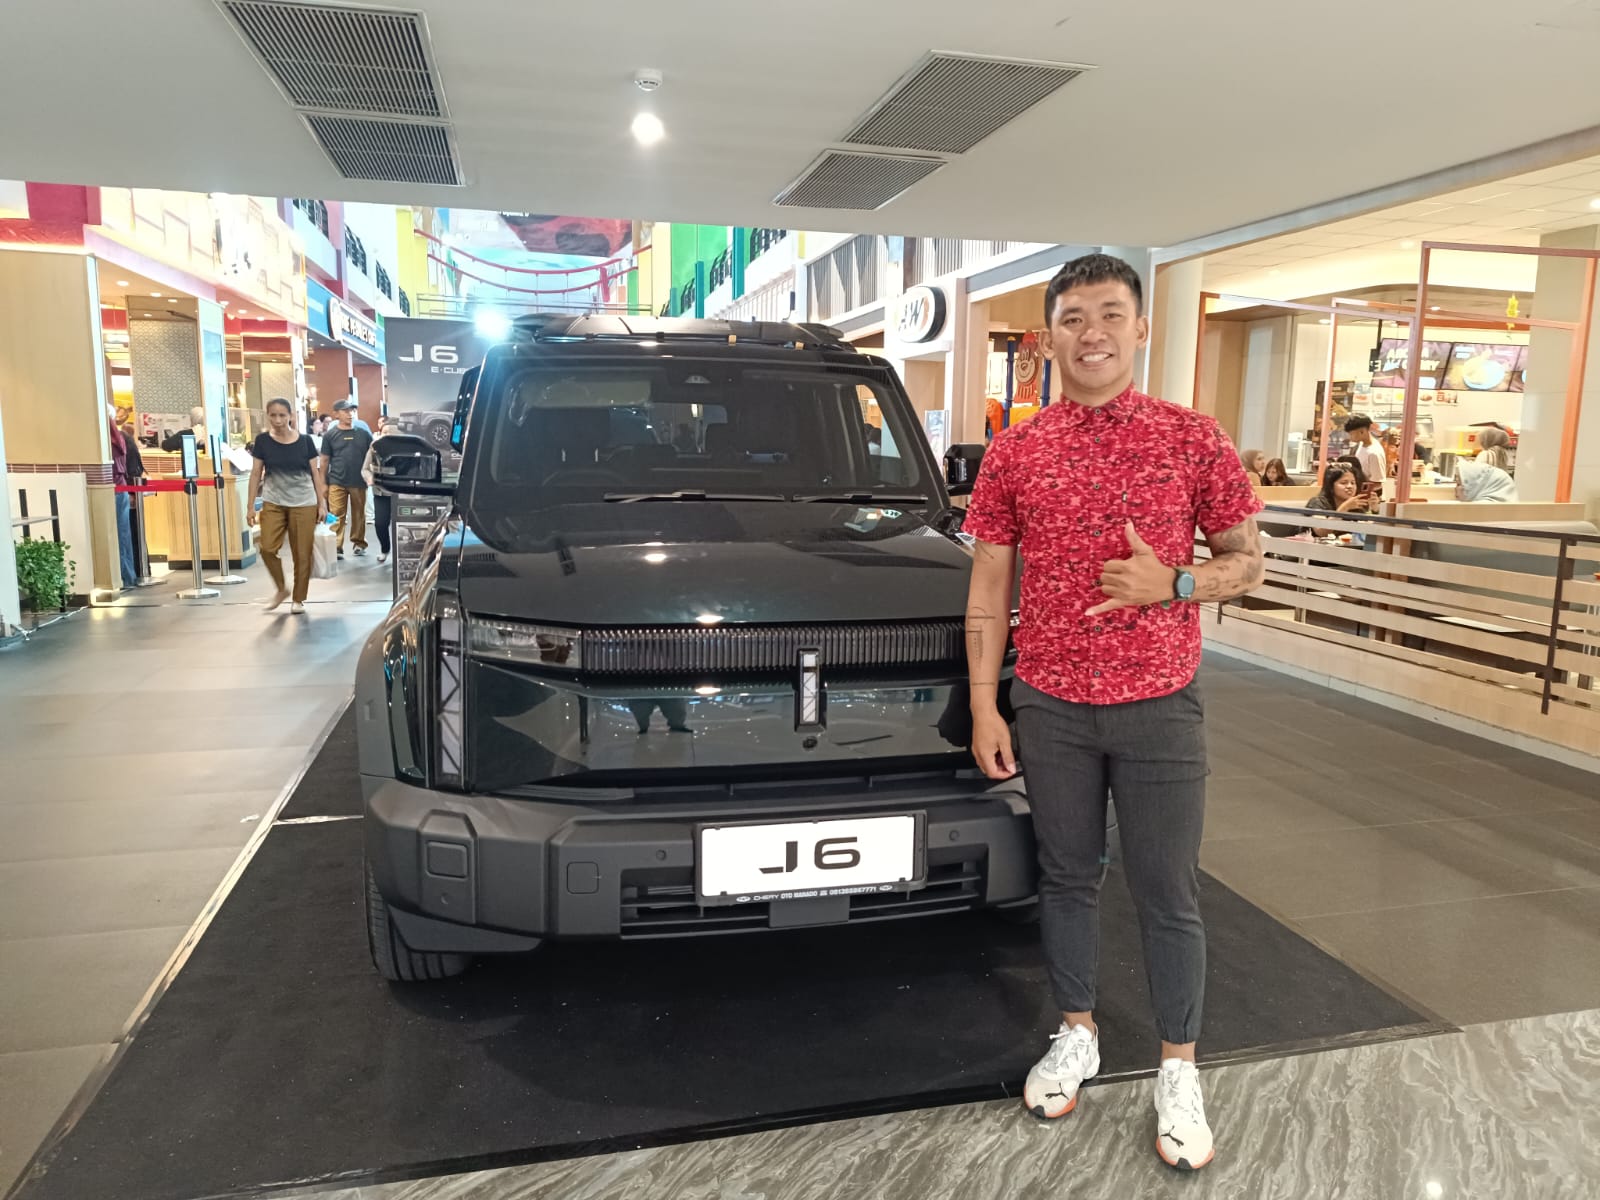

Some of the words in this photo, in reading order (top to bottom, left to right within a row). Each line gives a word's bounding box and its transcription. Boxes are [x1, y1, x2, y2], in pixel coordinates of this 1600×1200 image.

[398, 343, 459, 364] J6
[758, 836, 861, 874] J6
[753, 894, 779, 902] CHERY
